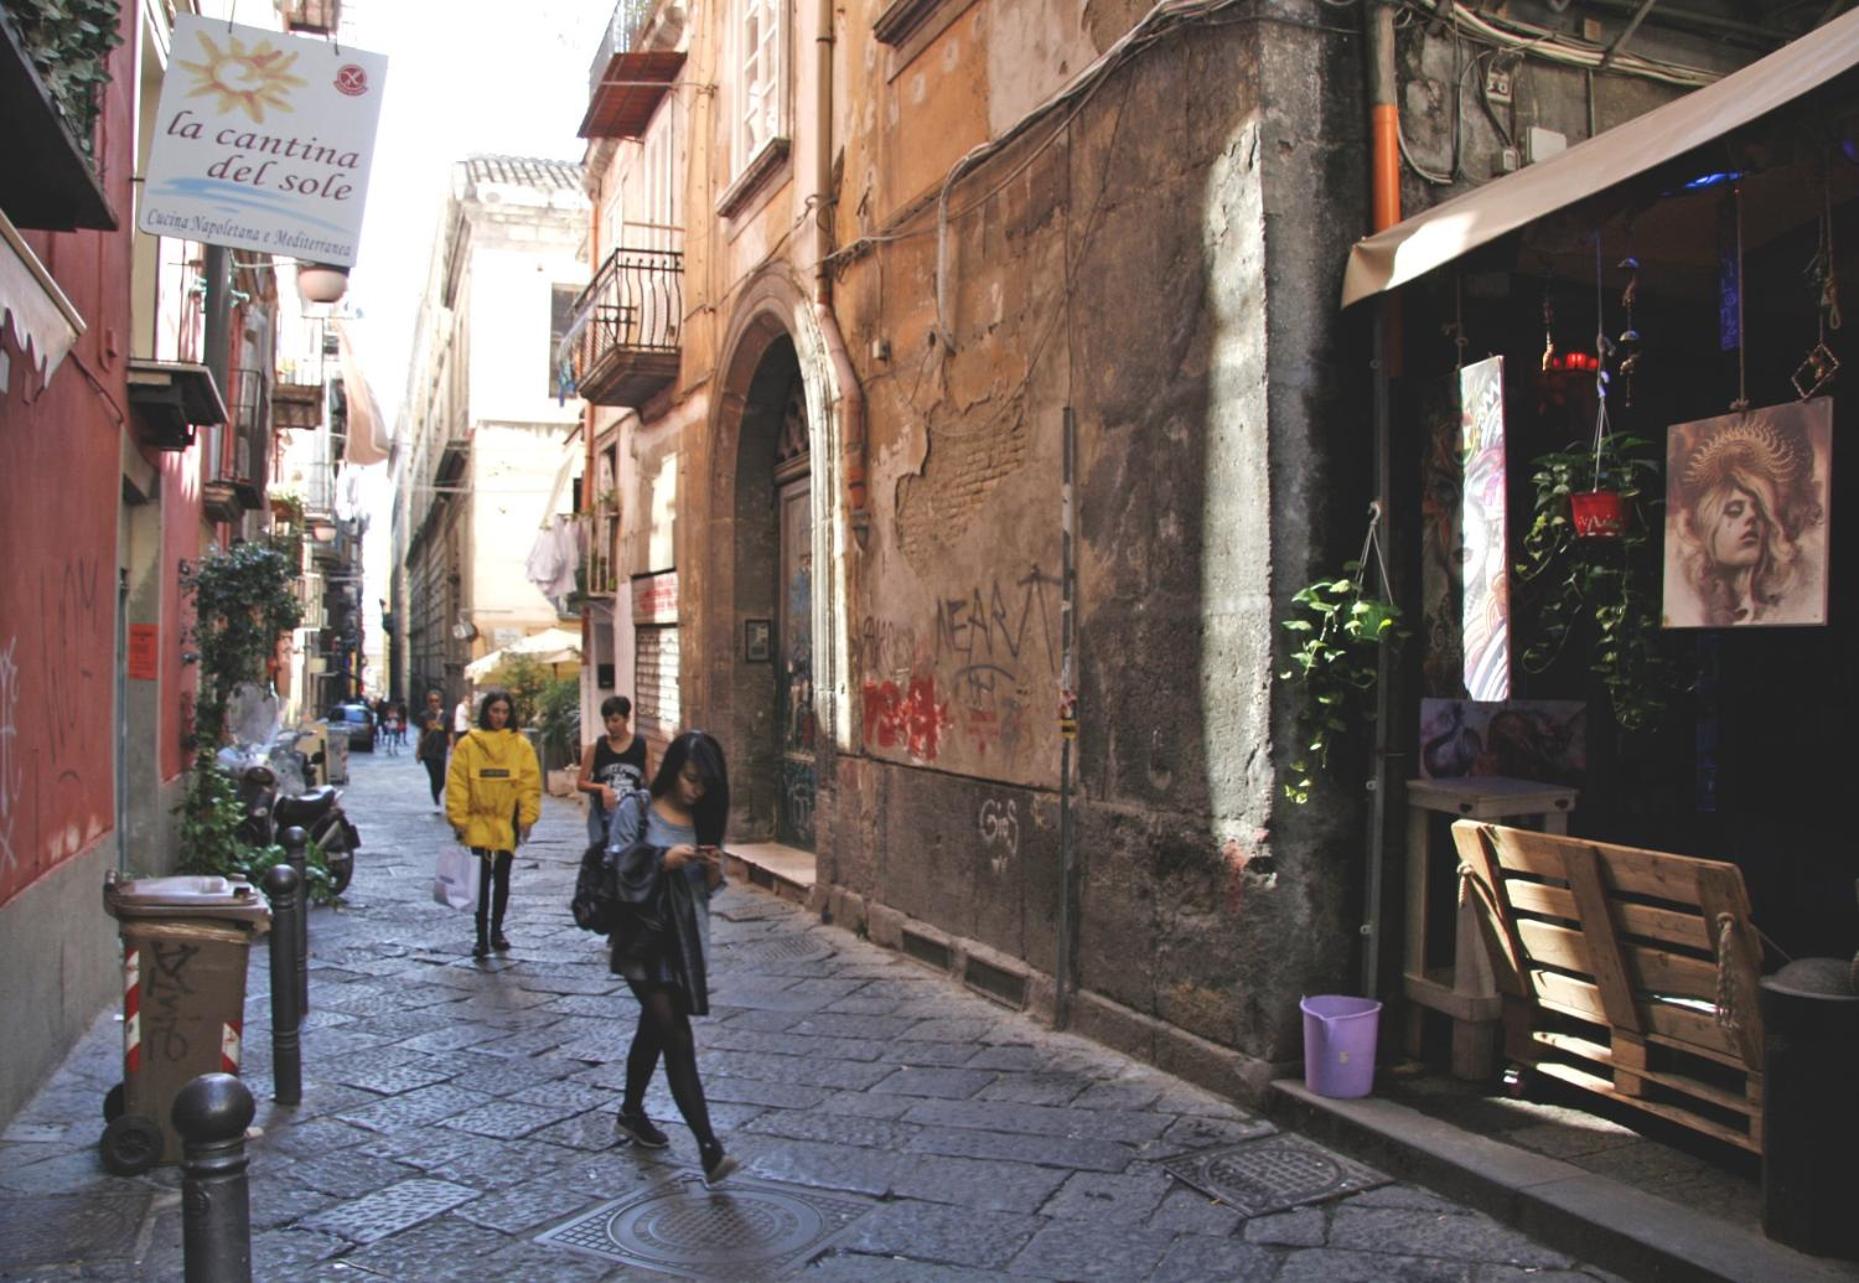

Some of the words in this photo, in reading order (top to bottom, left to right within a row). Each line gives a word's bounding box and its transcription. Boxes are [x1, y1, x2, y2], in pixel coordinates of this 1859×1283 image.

[166, 110, 204, 140] la
[215, 128, 360, 169] cantina
[206, 154, 278, 186] del
[277, 173, 353, 201] sole
[147, 208, 189, 230] Cucina
[190, 215, 260, 240] Napoletana
[263, 231, 271, 243] e
[273, 229, 352, 257] Mediterranea
